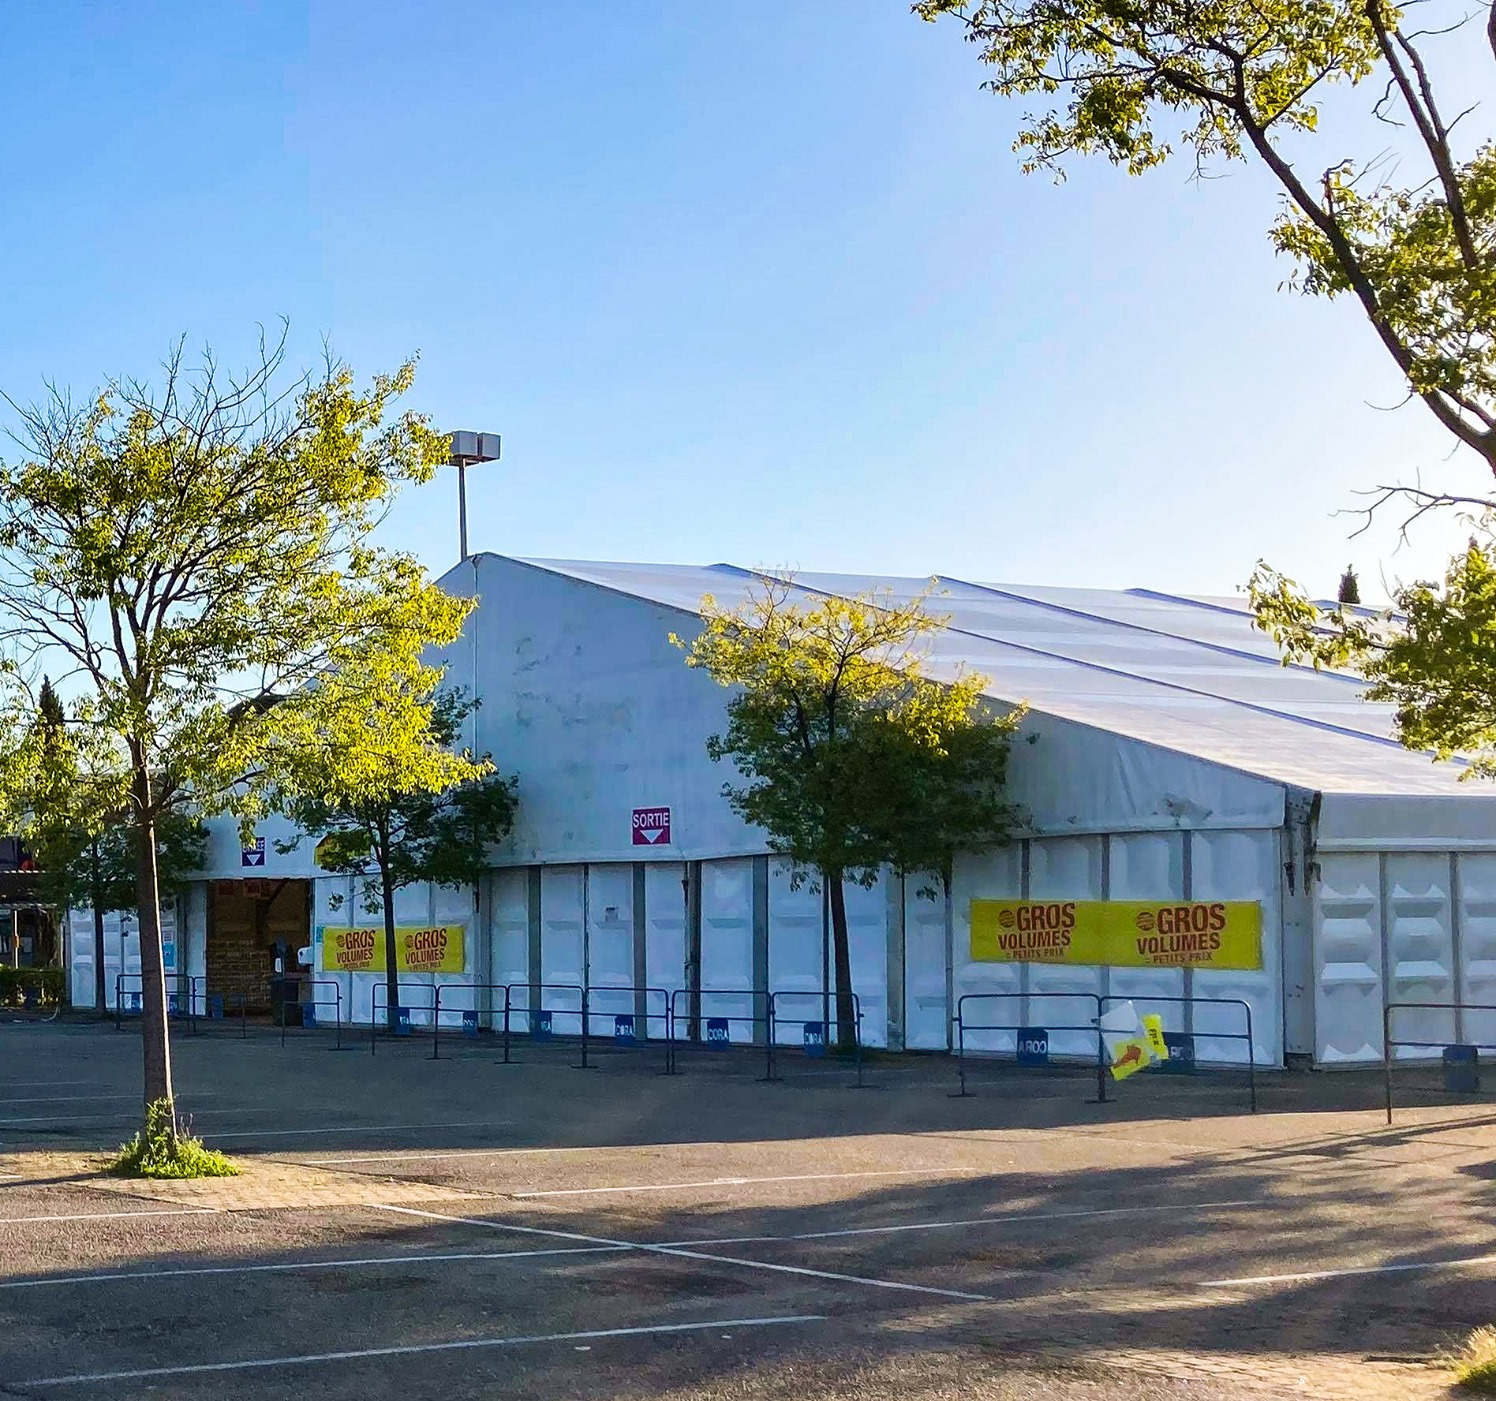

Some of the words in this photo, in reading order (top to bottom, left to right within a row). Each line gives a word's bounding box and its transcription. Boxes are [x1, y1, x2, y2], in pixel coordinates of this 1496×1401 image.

[633, 812, 669, 828] SORTIE
[1017, 902, 1076, 932] GROS
[1157, 903, 1226, 935] GROS
[345, 930, 376, 950] GROS
[414, 928, 447, 949] GROS
[998, 930, 1071, 950] VOLUMES
[1136, 932, 1221, 955] VOLUMES
[336, 948, 374, 964] VOLUMES
[405, 948, 445, 964] VOLUMES
[708, 1028, 729, 1041] CORA
